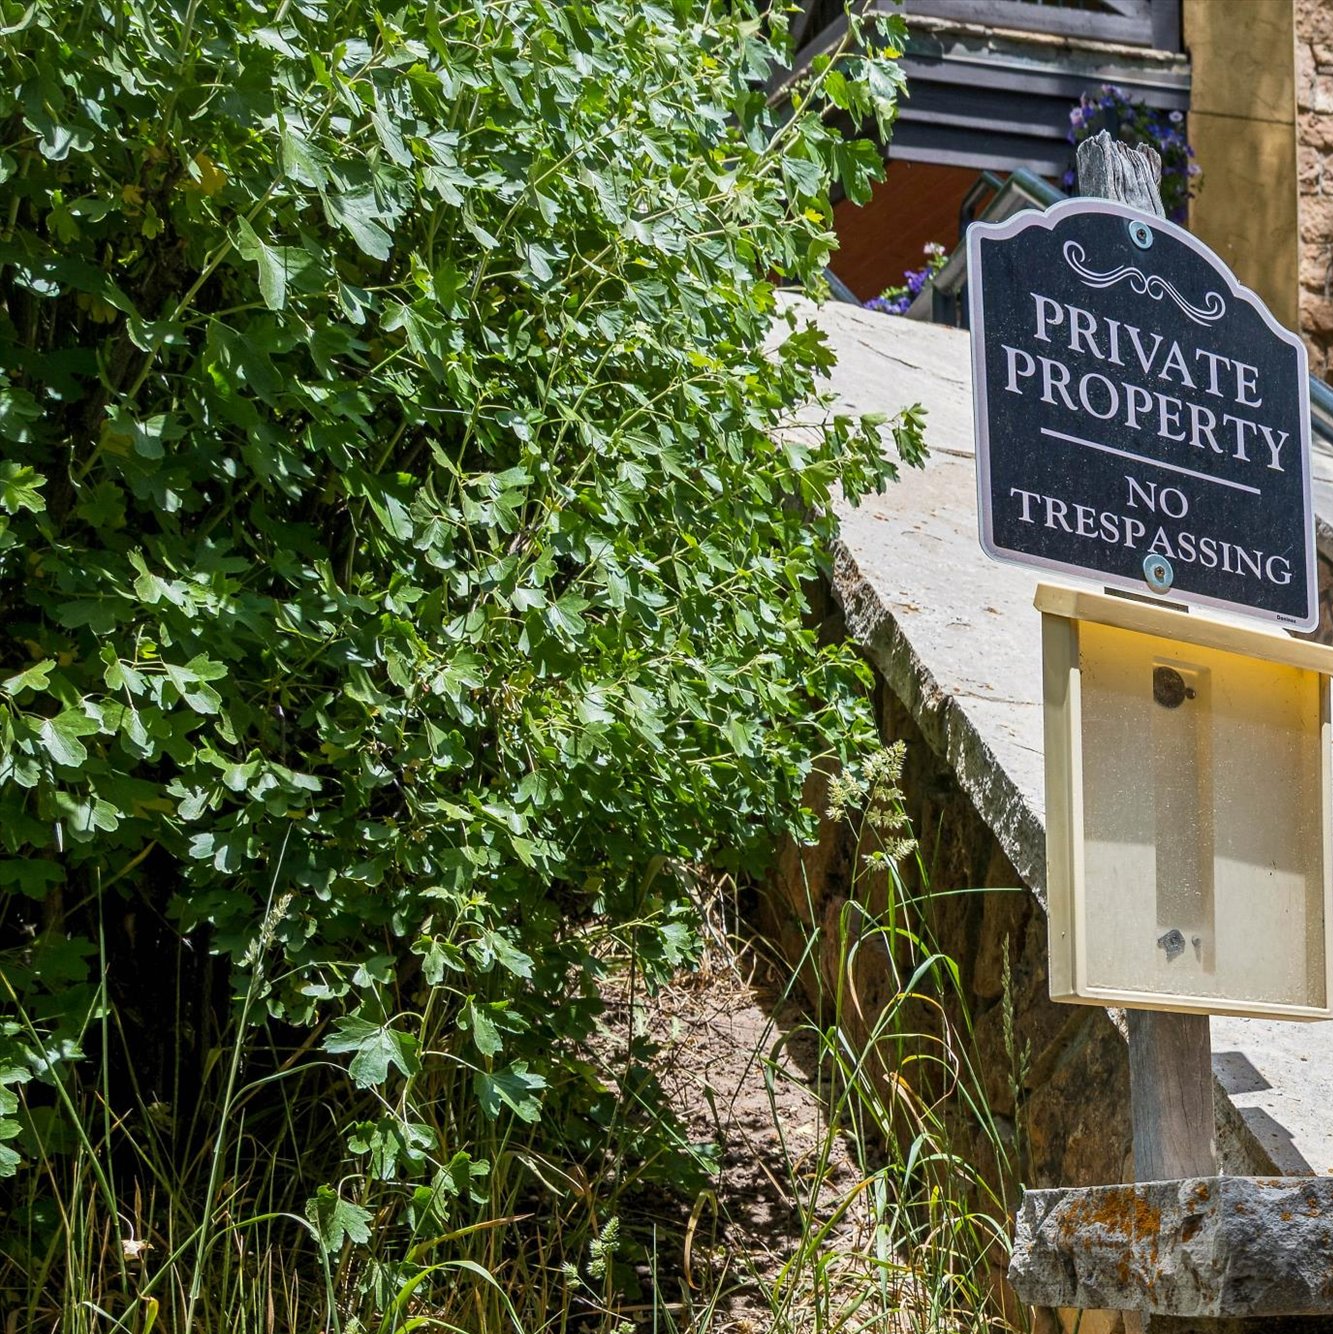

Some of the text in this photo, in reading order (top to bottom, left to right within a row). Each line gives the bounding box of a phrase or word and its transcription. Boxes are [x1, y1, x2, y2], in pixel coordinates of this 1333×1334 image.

[1030, 293, 1262, 407] PRIVATE
[1001, 345, 1289, 471] PROPERTY
[1011, 488, 1292, 585] TRESPASSING
[1125, 476, 1189, 519] NO
